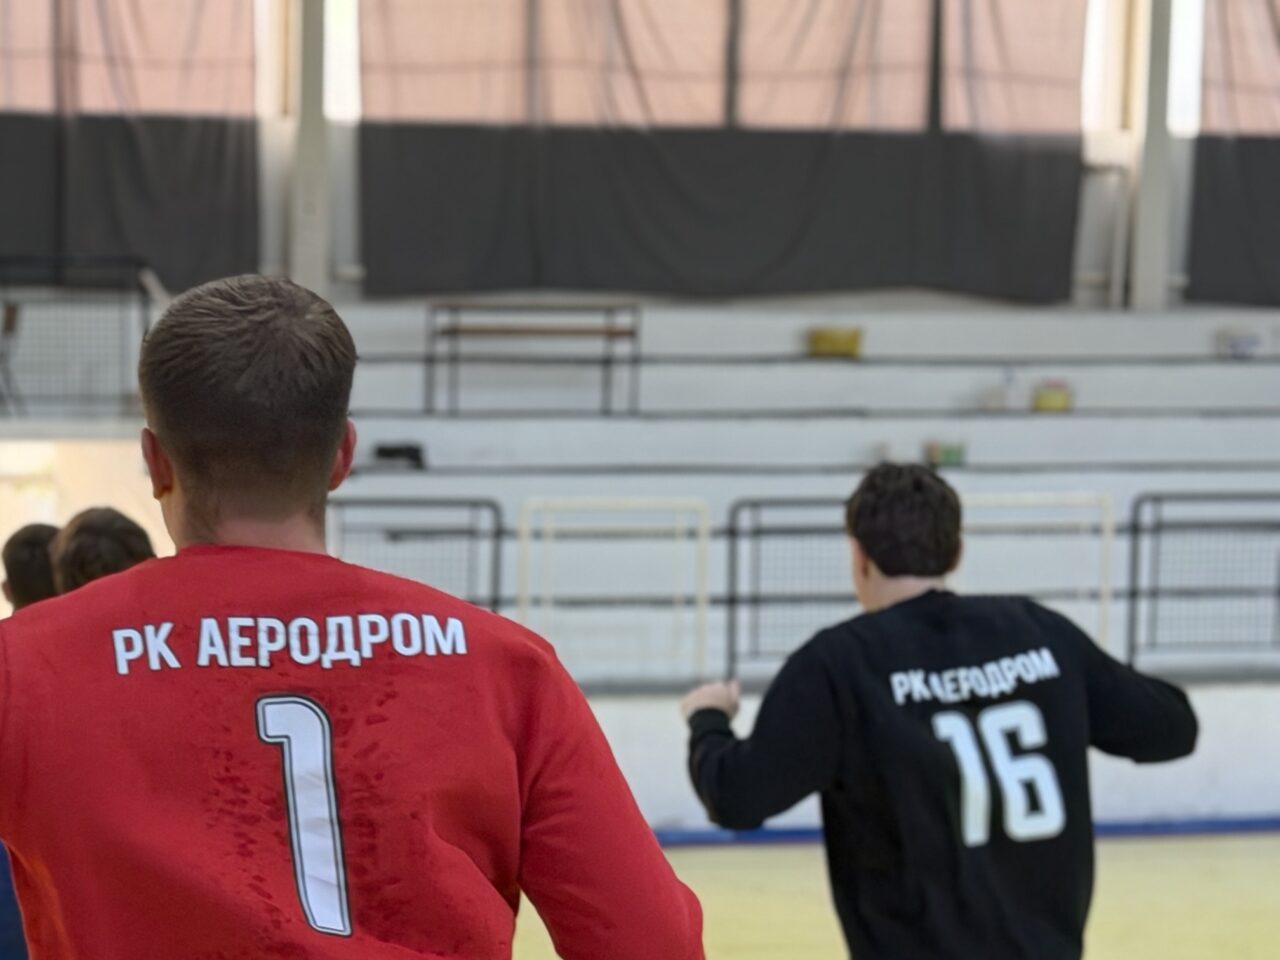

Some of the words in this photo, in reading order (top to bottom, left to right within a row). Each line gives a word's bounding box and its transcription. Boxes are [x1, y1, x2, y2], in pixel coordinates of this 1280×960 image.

[112, 622, 182, 675] РК
[197, 612, 467, 669] АЕРОДРОМ
[890, 669, 932, 706] РК
[256, 693, 352, 937] 1
[931, 699, 1067, 848] 16
